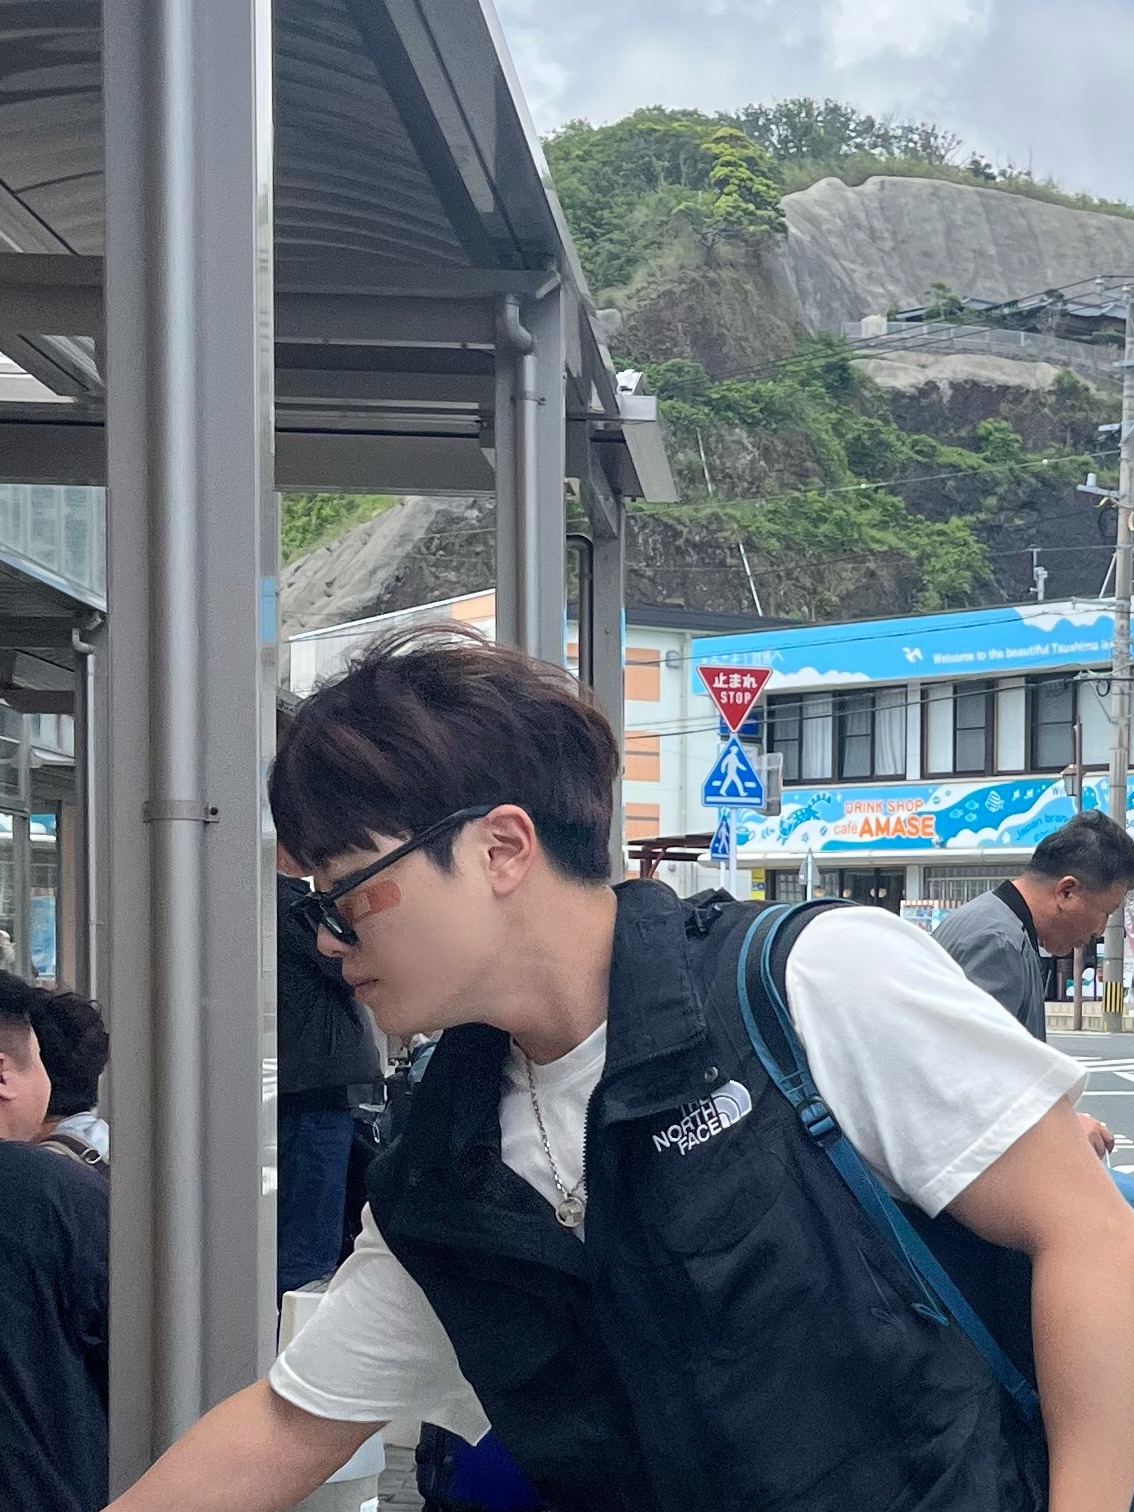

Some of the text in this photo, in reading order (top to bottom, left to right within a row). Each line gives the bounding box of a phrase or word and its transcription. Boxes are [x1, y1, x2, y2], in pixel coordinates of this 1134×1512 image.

[932, 652, 974, 665] Welcome
[976, 651, 987, 661] to
[988, 648, 1004, 660] the
[1005, 643, 1050, 659] beautiful
[1051, 640, 1100, 654] Tsushima
[712, 672, 758, 689] 止まれ
[720, 690, 752, 705] STOP
[845, 799, 923, 814] DRINK SHOP
[858, 816, 935, 838] AMASE
[652, 1102, 717, 1152] NORTH
[677, 1117, 722, 1156] FACE
